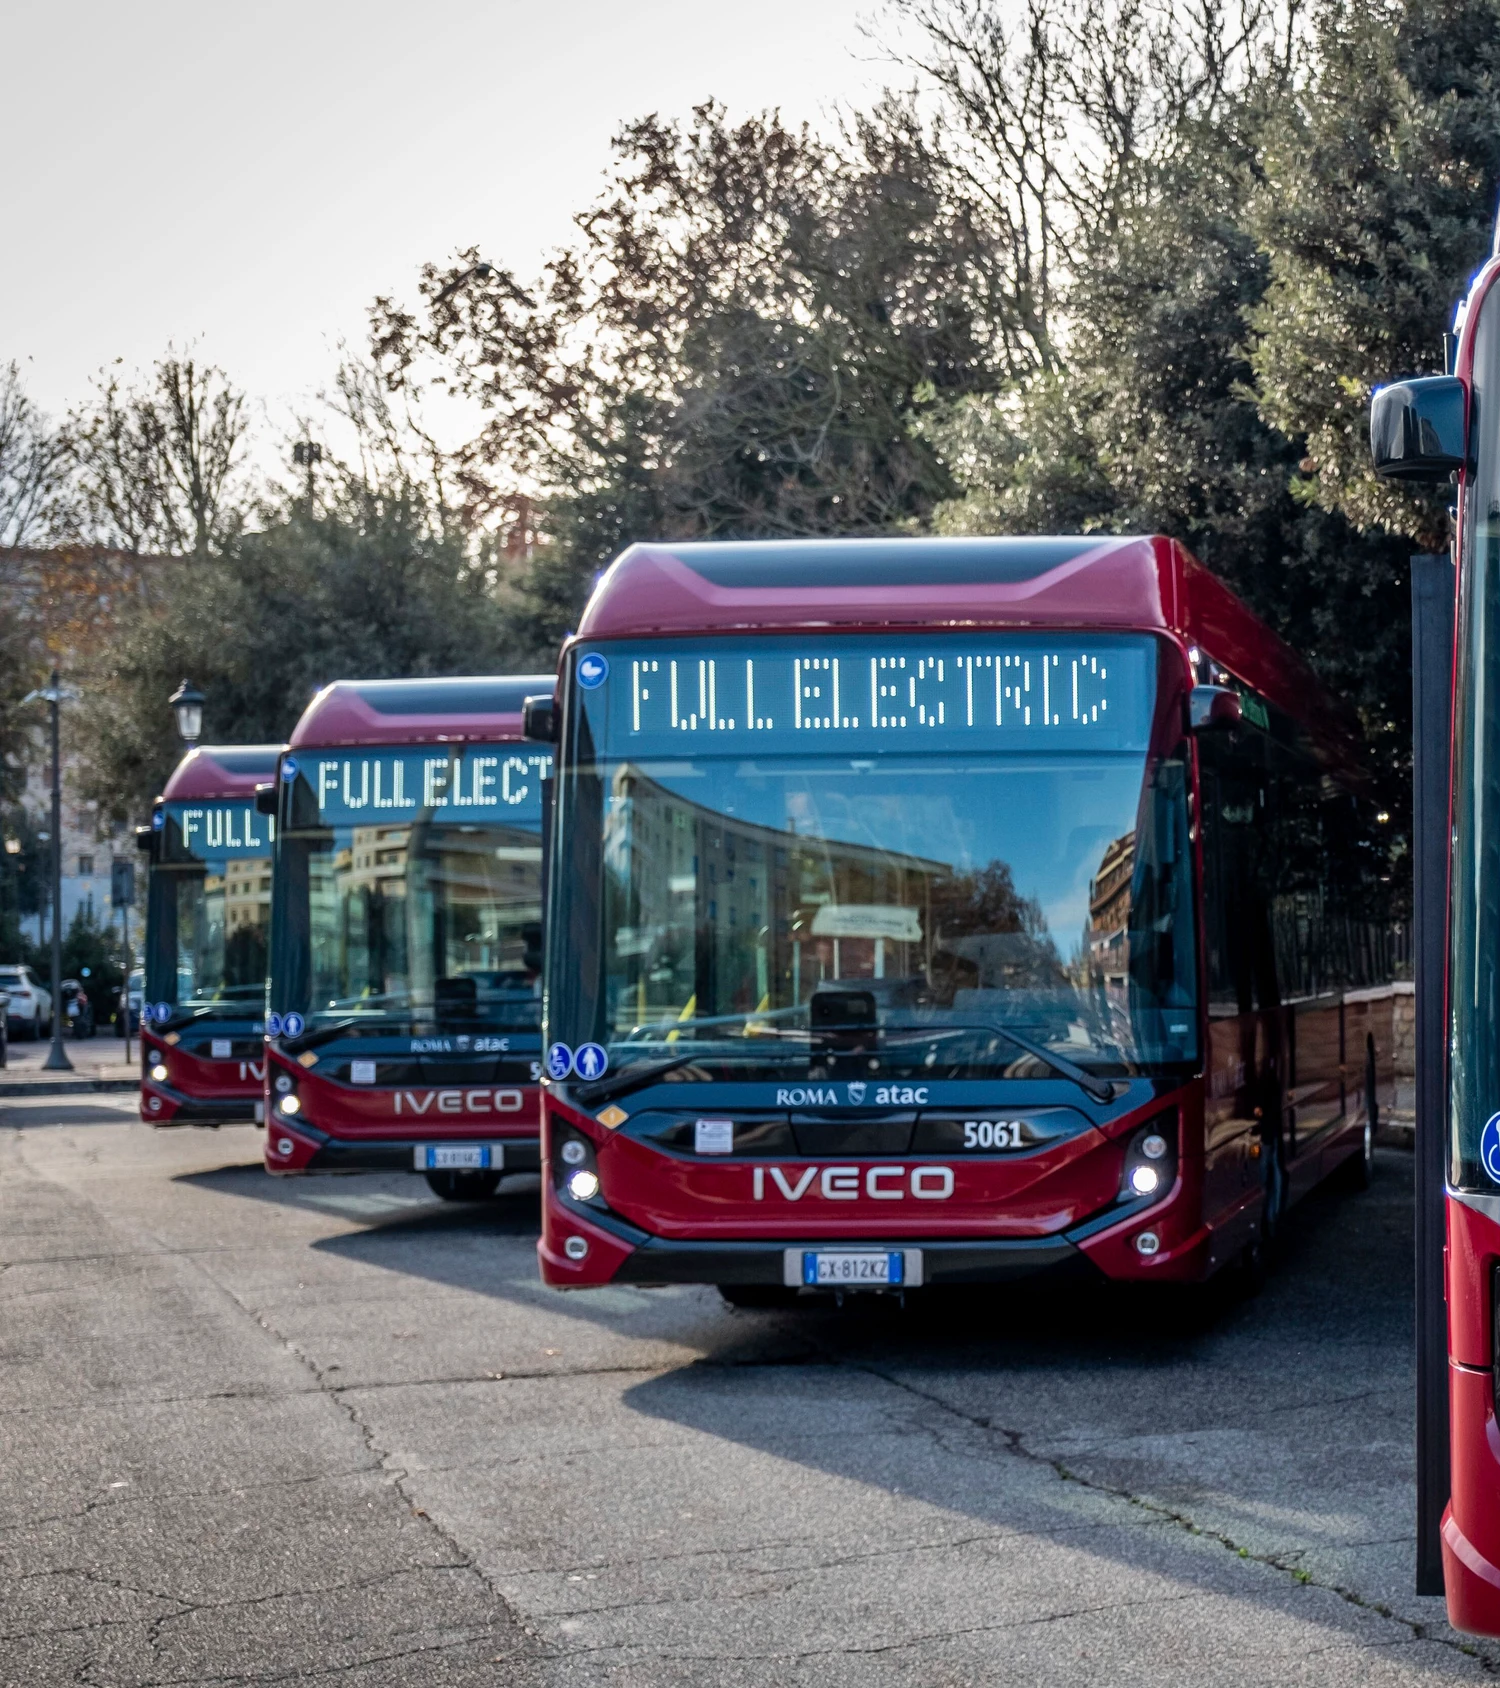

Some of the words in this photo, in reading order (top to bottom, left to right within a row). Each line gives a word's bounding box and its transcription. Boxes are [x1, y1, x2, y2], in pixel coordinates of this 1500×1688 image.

[632, 660, 773, 731] FULL
[795, 655, 1107, 729] ELECTRIC
[318, 760, 416, 810] FULL
[424, 756, 554, 806] ELECT
[183, 808, 261, 848] FULL
[474, 1037, 509, 1051] atac
[393, 1089, 523, 1115] IVECO
[777, 1088, 838, 1106] ROMA
[875, 1085, 929, 1104] atac
[964, 1121, 1024, 1148] 5061
[753, 1166, 955, 1201] IVECO
